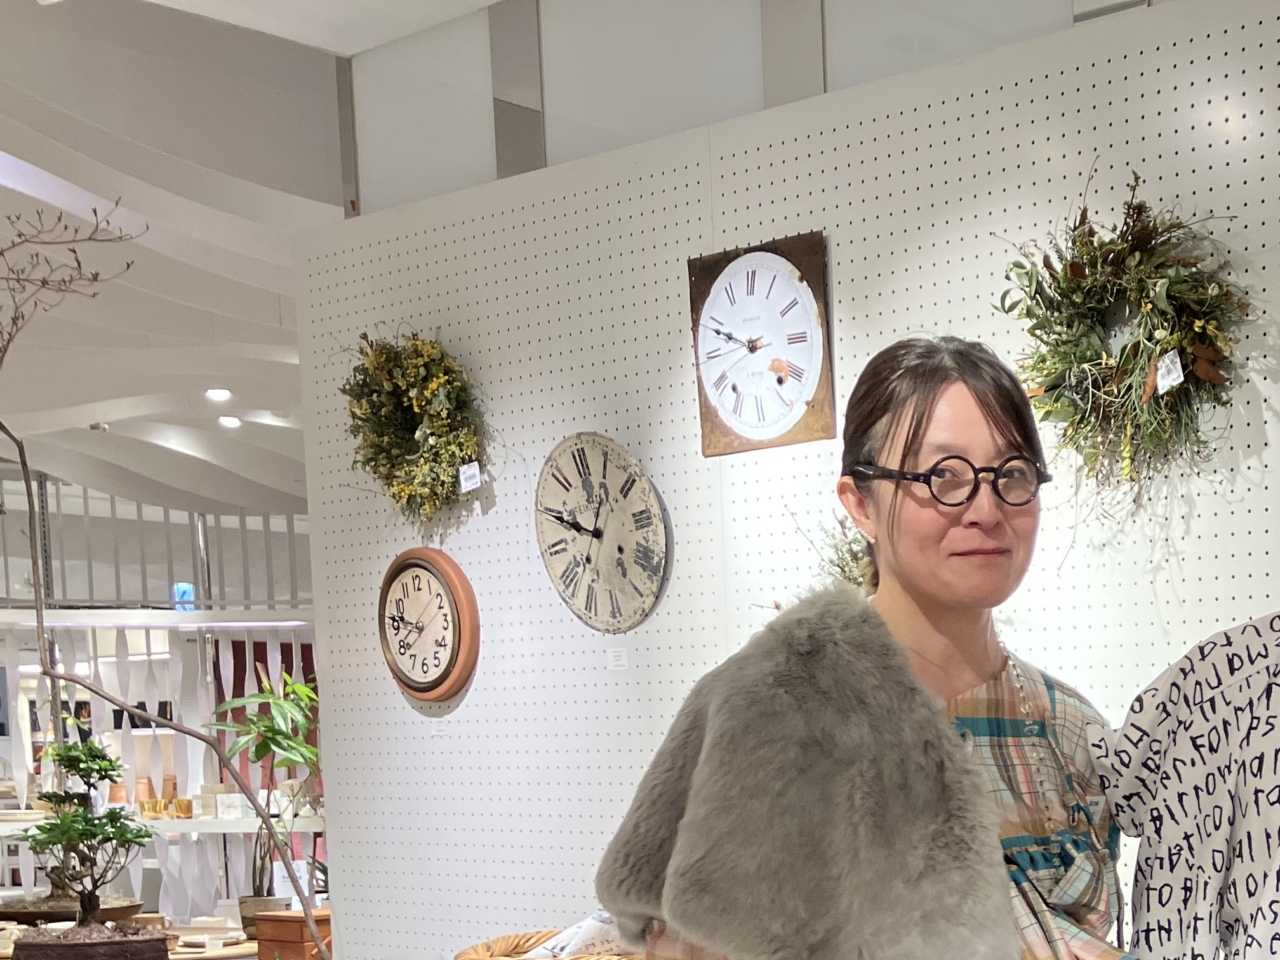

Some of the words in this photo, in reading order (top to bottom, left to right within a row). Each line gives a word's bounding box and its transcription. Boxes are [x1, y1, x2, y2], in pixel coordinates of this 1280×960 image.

[402, 582, 409, 599] 11
[412, 574, 422, 592] 12
[427, 578, 432, 595] 1
[395, 598, 405, 616] 10
[436, 592, 444, 609] 2
[442, 613, 449, 631] 3
[398, 639, 407, 656] 8
[439, 635, 448, 651] 4
[409, 654, 417, 670] 7
[421, 657, 429, 674] 6
[433, 651, 441, 668] 5
